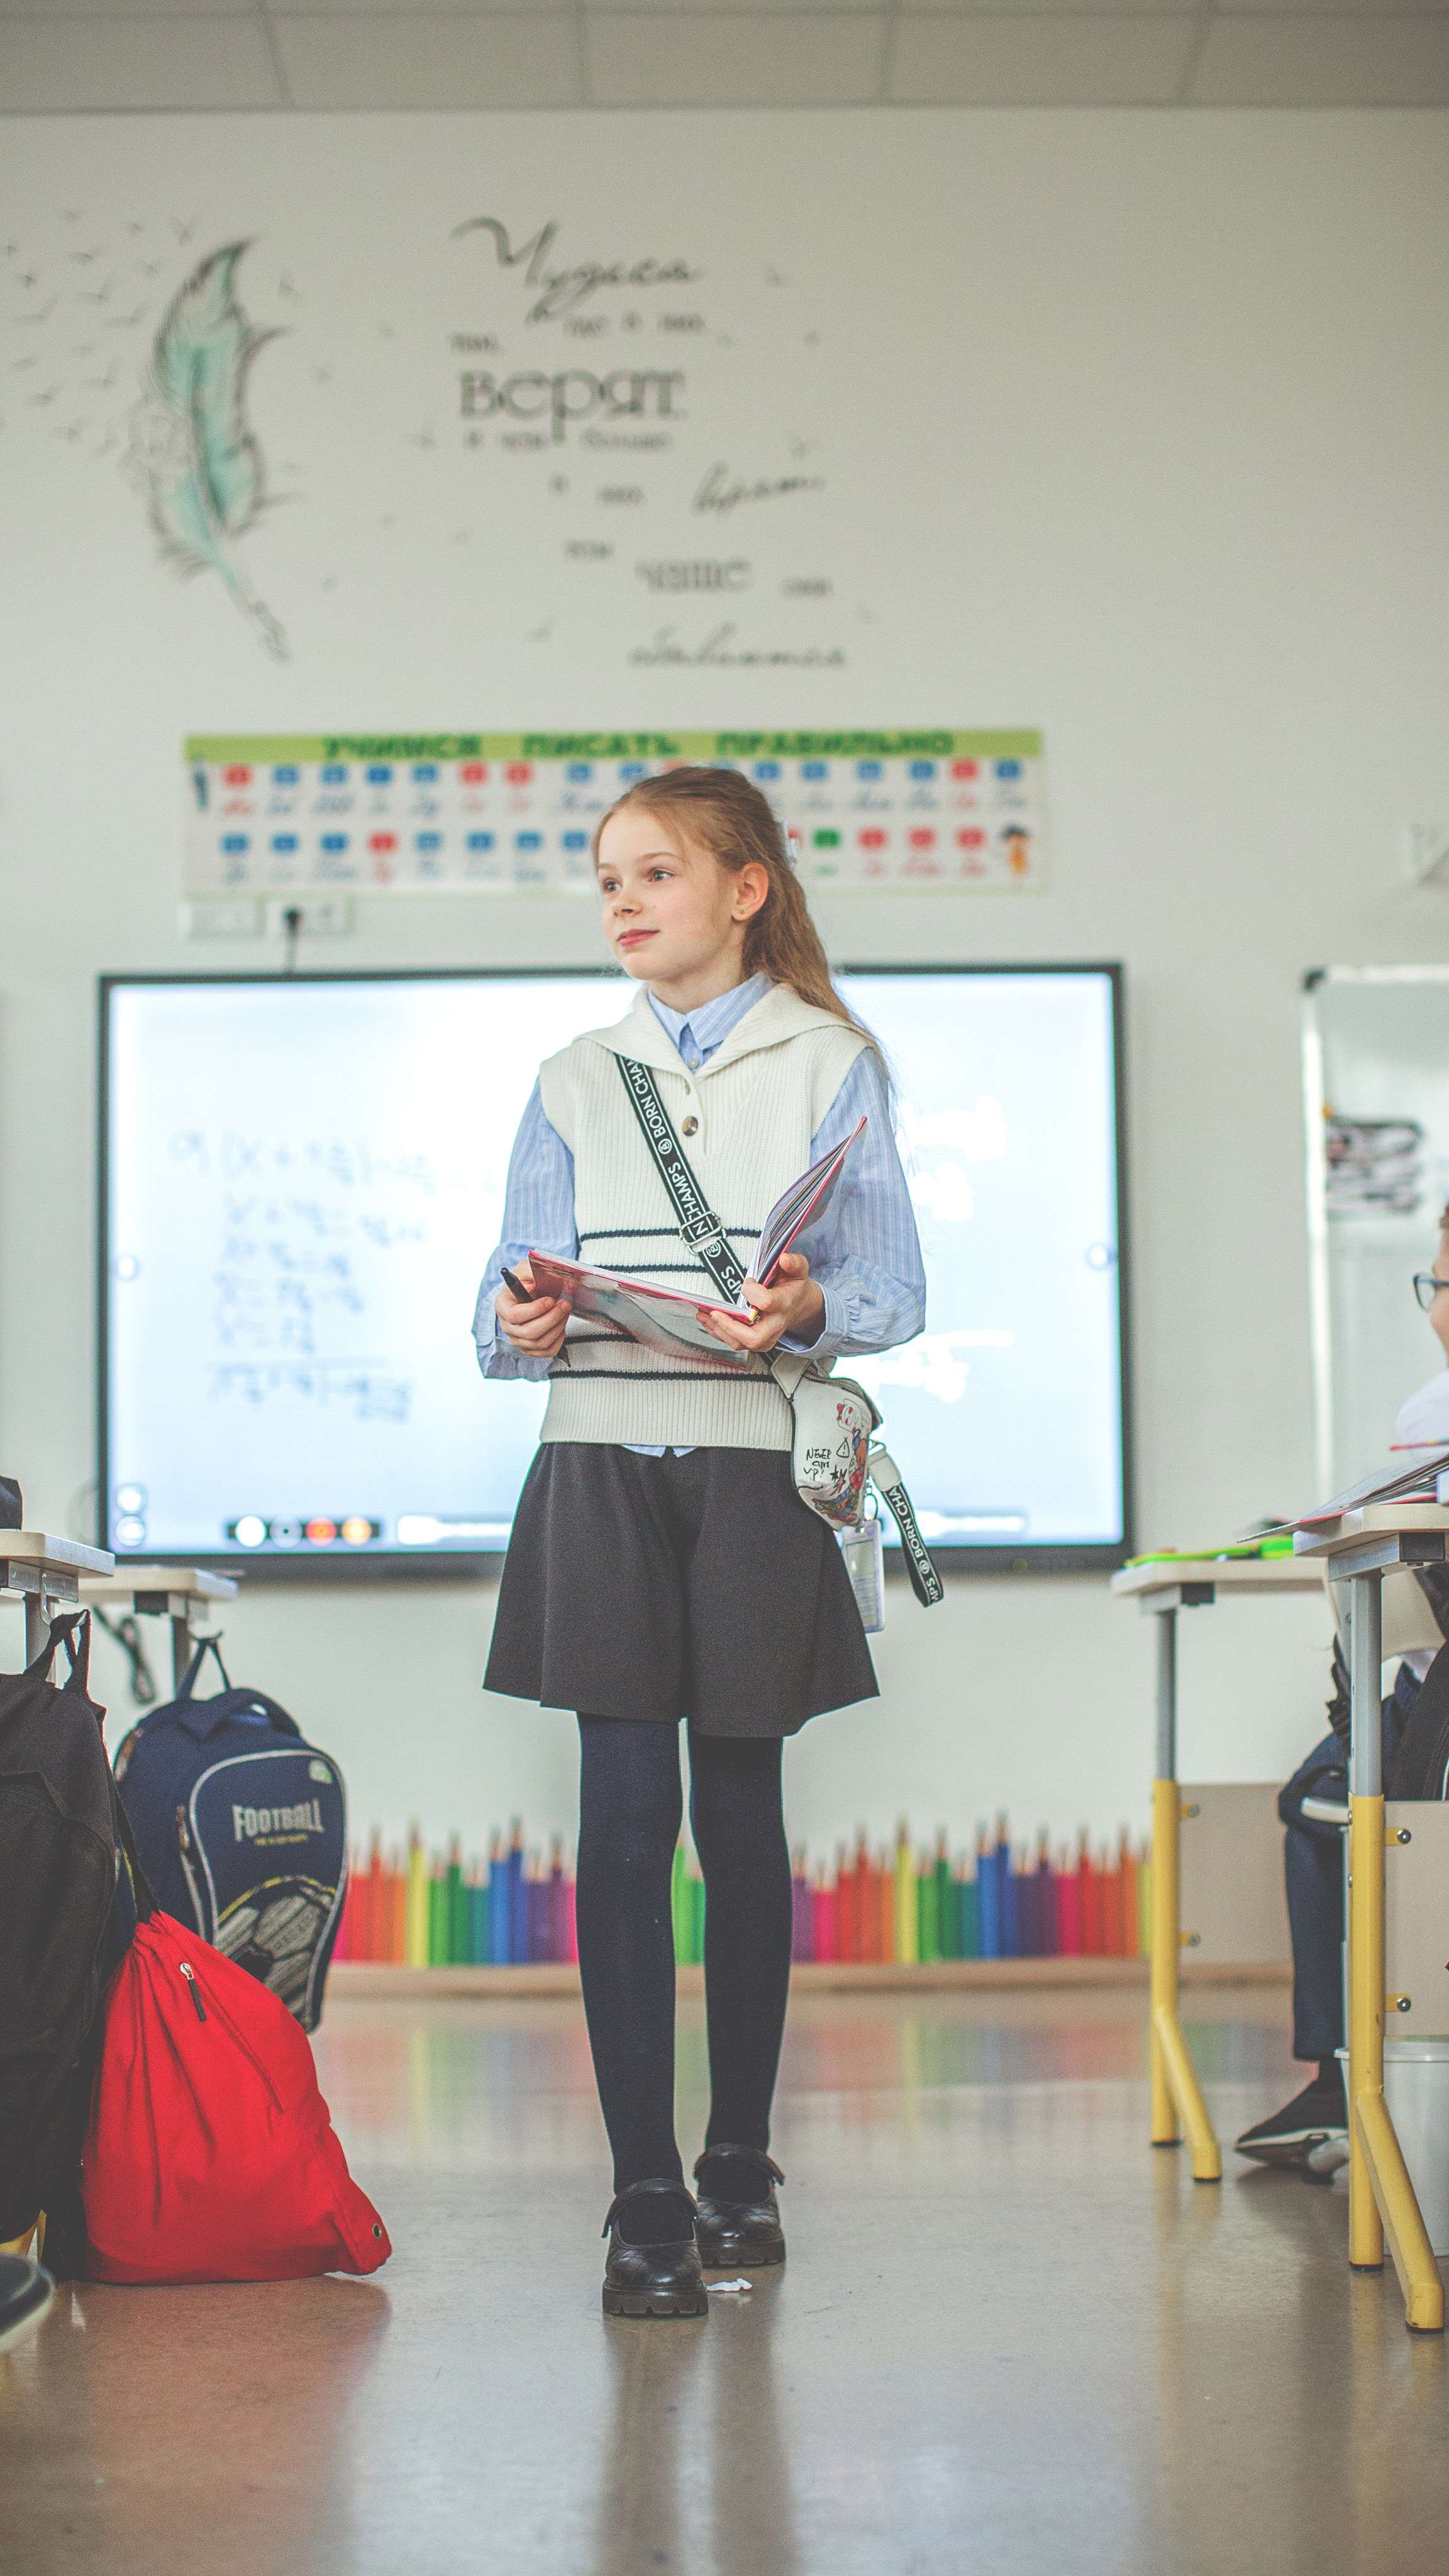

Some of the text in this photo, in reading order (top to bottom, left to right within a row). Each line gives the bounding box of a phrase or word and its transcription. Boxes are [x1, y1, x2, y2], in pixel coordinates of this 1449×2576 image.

[641, 1094, 667, 1139] BORN
[806, 1447, 832, 1460] NEVER
[903, 1518, 924, 1558] BORN
[231, 1797, 325, 1843] FOOTBALL
